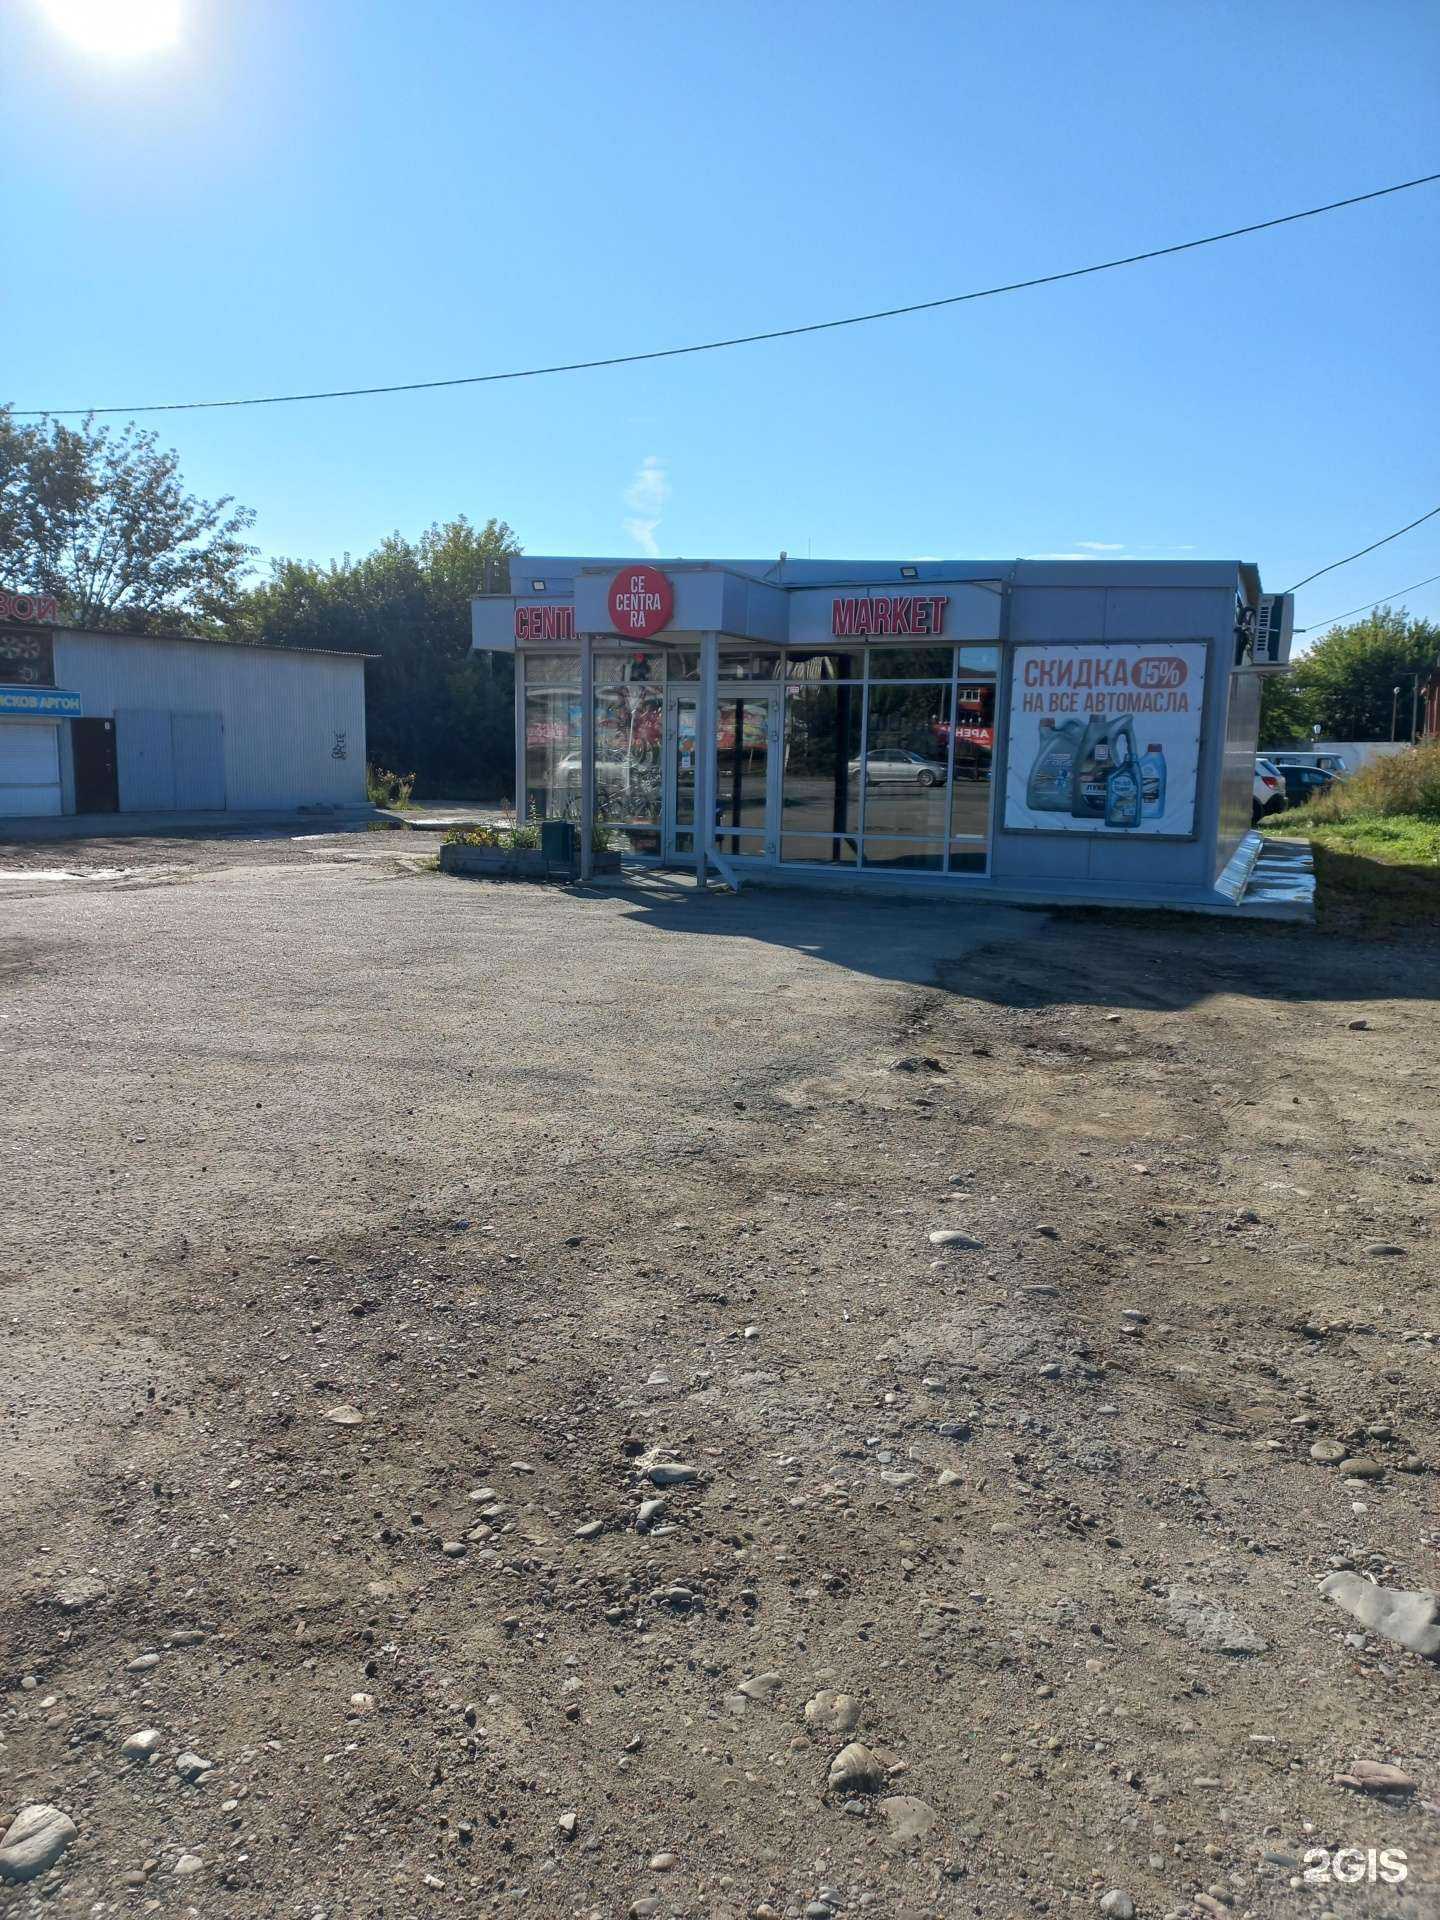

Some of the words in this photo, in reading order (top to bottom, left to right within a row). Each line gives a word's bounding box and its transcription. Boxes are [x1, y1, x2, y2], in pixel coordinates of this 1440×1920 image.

[630, 575, 645, 592] CE
[616, 593, 661, 611] CENTRA
[515, 606, 582, 640] CENT
[630, 611, 646, 627] RA
[832, 595, 948, 635] MARKET
[1024, 658, 1128, 689] СКИДКА
[1139, 661, 1180, 685] 15%
[1023, 692, 1044, 712] НА
[1048, 692, 1080, 712] ВСЕ
[1083, 692, 1189, 712] АВТОМАСЛА
